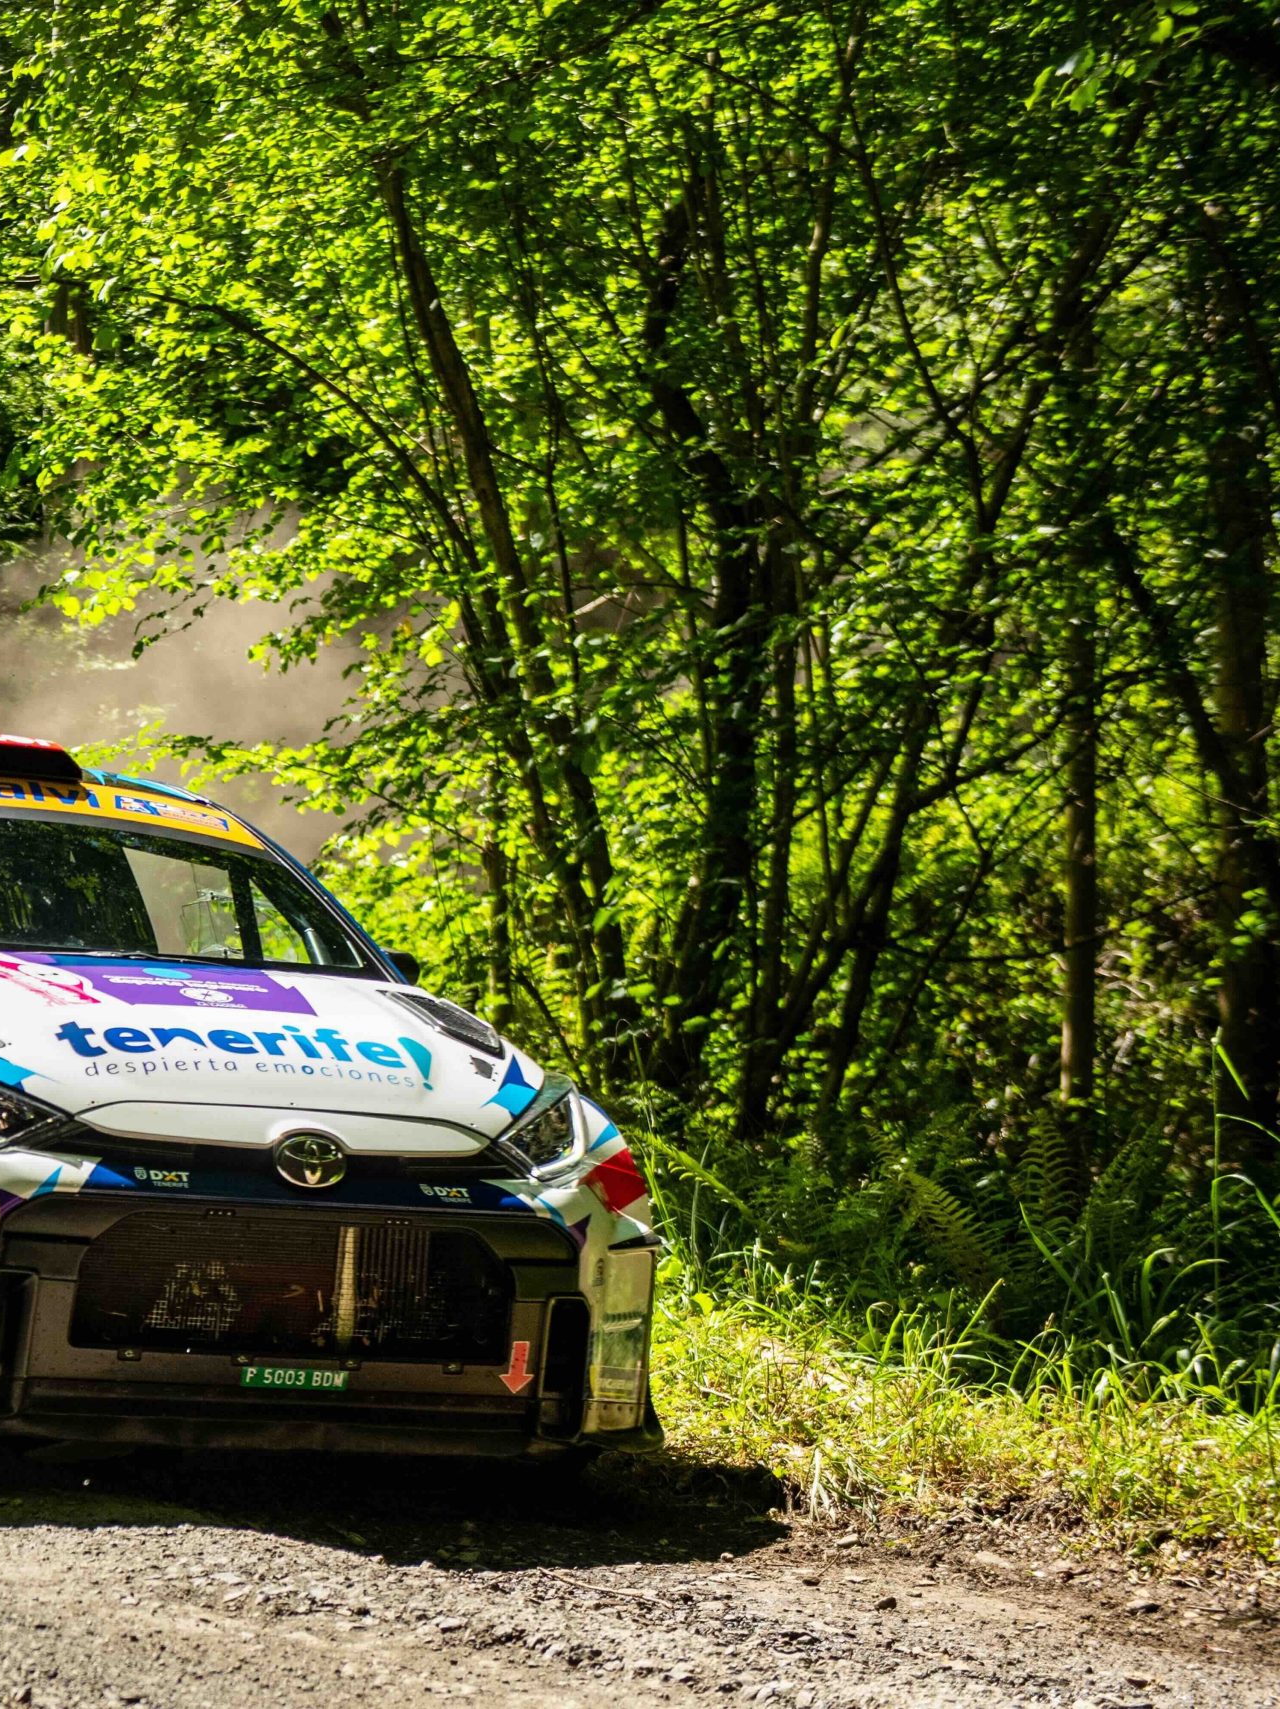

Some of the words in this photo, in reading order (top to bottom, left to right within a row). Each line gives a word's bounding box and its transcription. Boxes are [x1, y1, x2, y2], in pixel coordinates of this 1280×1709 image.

[85, 1057, 238, 1077] despierta
[256, 1062, 415, 1089] emociones
[149, 1170, 190, 1182] DXT
[433, 1187, 468, 1198] DXT
[263, 1369, 306, 1386] 5003
